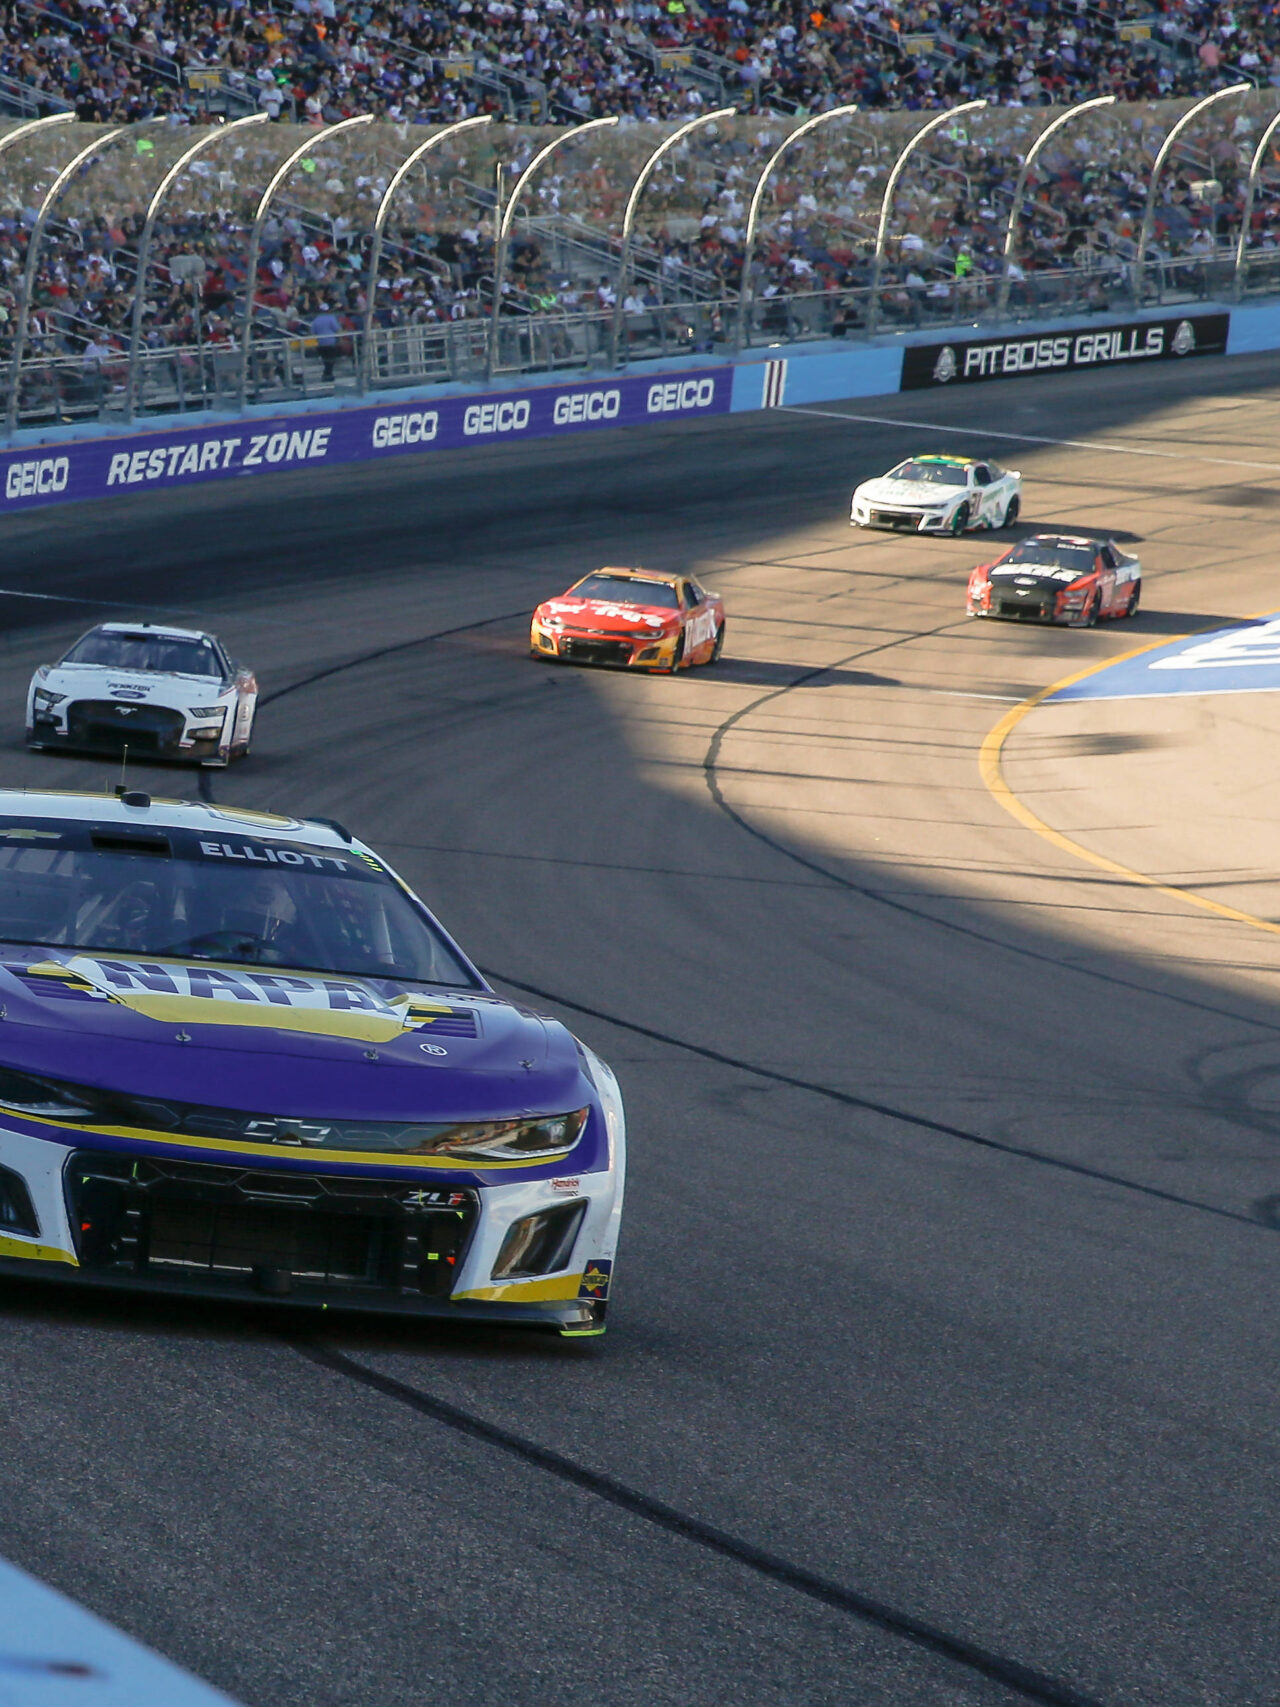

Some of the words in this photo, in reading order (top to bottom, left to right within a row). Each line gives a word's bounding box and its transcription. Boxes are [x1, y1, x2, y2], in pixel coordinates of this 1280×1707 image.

[964, 345, 1004, 377] PIT
[1002, 337, 1070, 373] BOSS
[1074, 327, 1164, 364] GRILLS
[5, 456, 70, 499] GEICO
[107, 437, 242, 487] RESTART
[242, 427, 332, 466] ZONE
[372, 411, 438, 449] GEICO
[463, 399, 530, 437] GEICO
[553, 389, 620, 426] GEICO
[647, 377, 714, 414] GEICO
[200, 841, 348, 872] ELLIOTT
[94, 959, 400, 1017] NAPA
